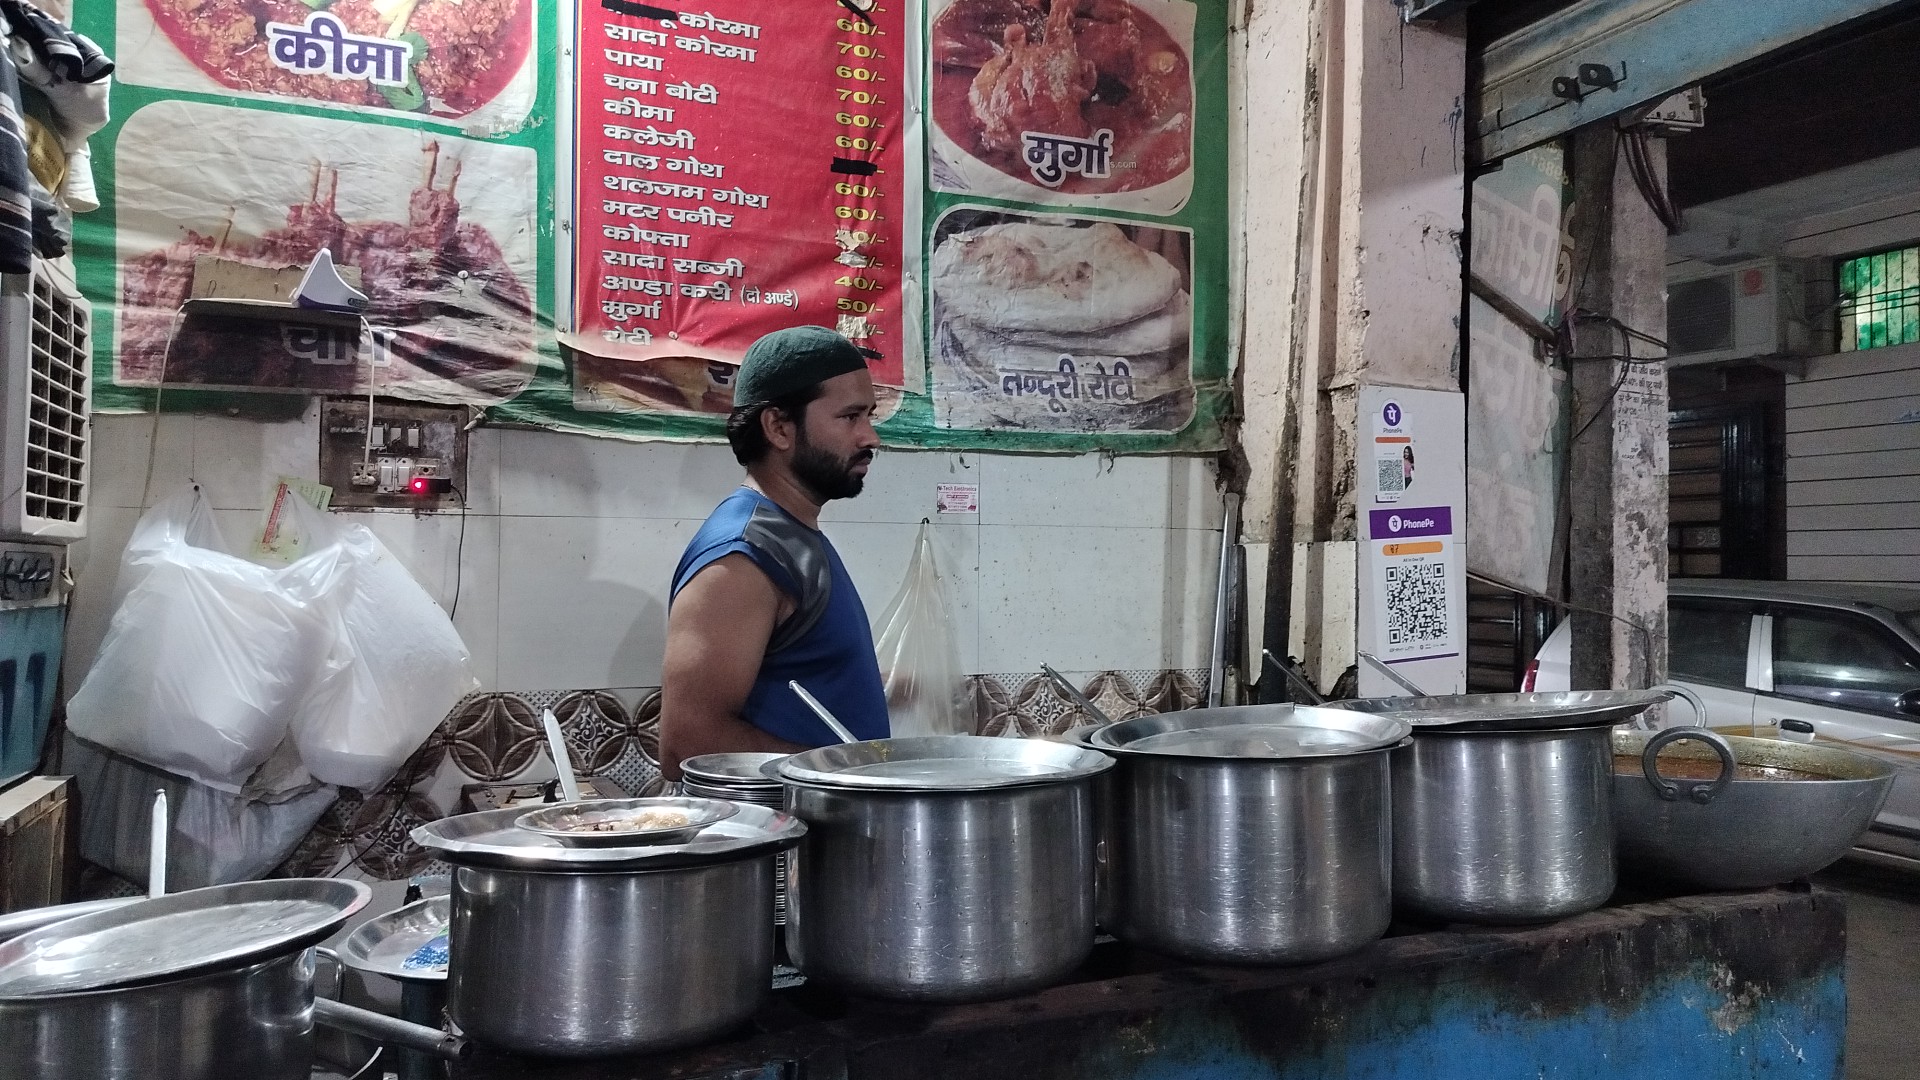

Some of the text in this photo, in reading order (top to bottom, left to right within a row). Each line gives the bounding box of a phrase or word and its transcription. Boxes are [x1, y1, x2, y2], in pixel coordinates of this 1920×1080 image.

[678, 11, 762, 39] कोरमा
[836, 18, 886, 36] 60/-
[272, 16, 407, 83] कीमा
[603, 22, 758, 63] सादा कोरमा
[836, 41, 886, 59] 70/-
[603, 48, 665, 71] पाया
[835, 65, 886, 82] 60/-
[603, 73, 720, 105] चना बोटी
[835, 88, 886, 105] 70/-
[602, 96, 676, 122] कीमा
[835, 112, 885, 128] 60/-
[602, 124, 697, 150] कलेजी
[835, 135, 885, 151] 60/-
[602, 149, 725, 178] दाल गोश
[1026, 133, 1110, 182] मुर्गा
[603, 174, 770, 209] शलजम गोश
[835, 182, 885, 198] 60/-
[602, 199, 735, 228] मटर पनीर
[835, 206, 885, 221] 60/-
[602, 223, 691, 248] कोफ्ता
[602, 249, 746, 278] सादा सब्जी
[602, 275, 800, 311] अण्डा करी (दो अण्डे)
[834, 275, 884, 291] 40/-
[602, 300, 663, 322] मुर्गा
[836, 297, 885, 314] 50/-
[602, 325, 654, 346] रोटी
[998, 357, 1135, 413] तन्दूरी रोटी
[1403, 518, 1435, 529] PhonePe
